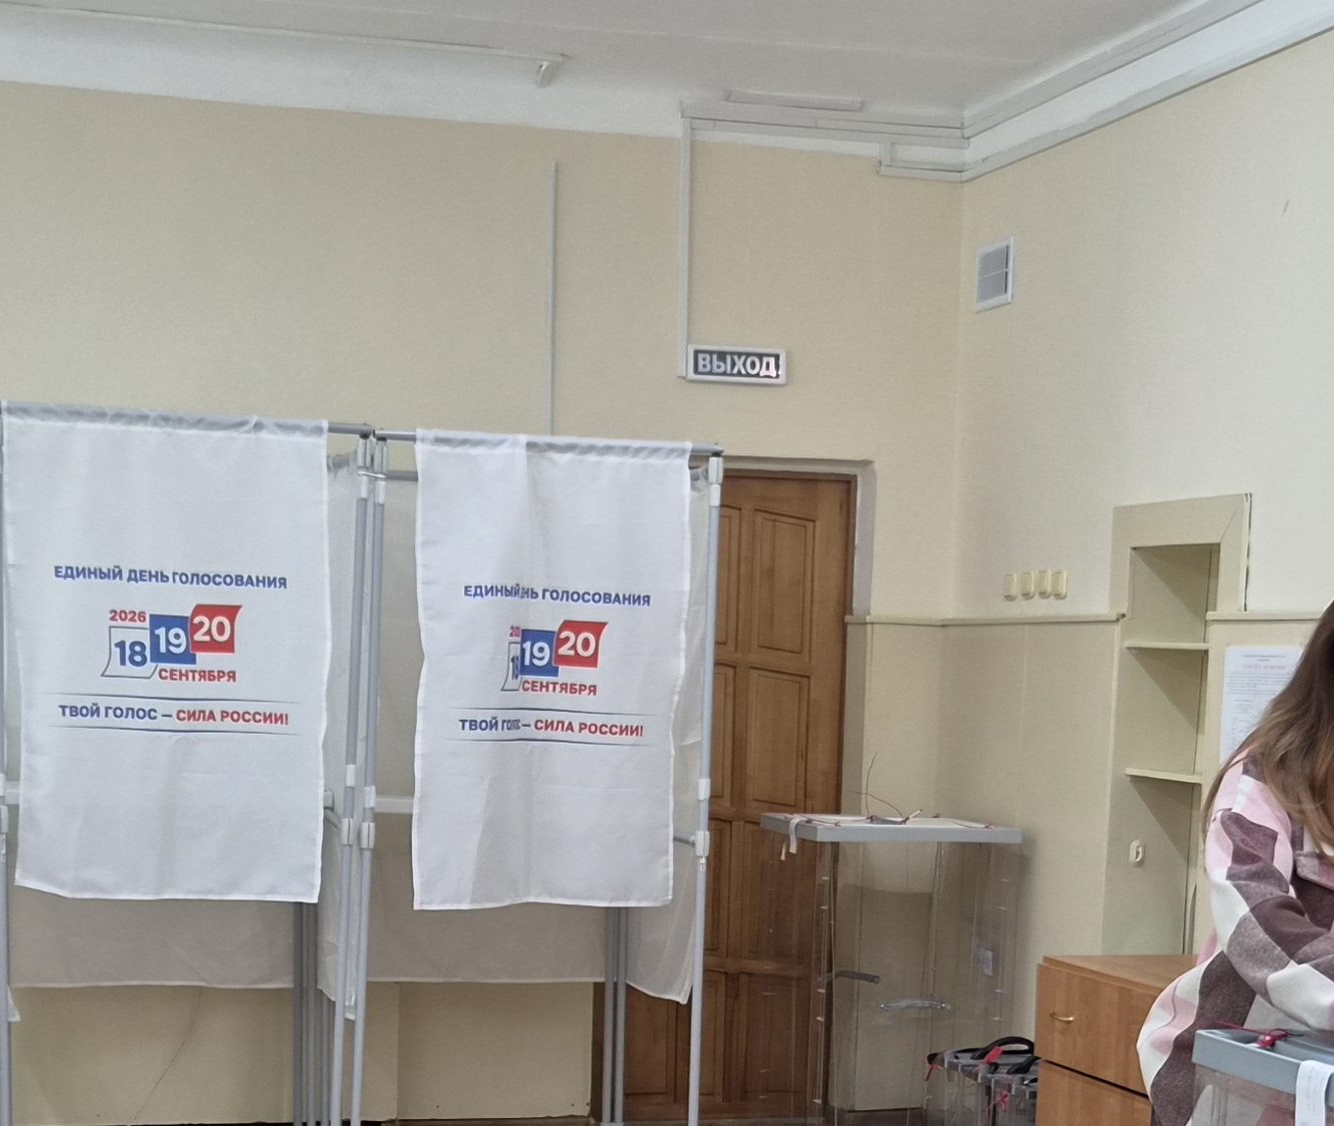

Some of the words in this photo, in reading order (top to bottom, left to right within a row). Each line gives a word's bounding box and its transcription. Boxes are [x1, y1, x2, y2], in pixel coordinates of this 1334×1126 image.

[697, 352, 777, 378] ВЫХОД
[54, 564, 124, 583] ЕДИНЫЙ
[126, 569, 170, 585] ДЕНЬ
[171, 571, 288, 590] ГОЛОСОВАНИЯ
[541, 588, 651, 607] ГОЛОСОВАНИЯ
[109, 609, 147, 623] 2026
[113, 640, 148, 667] 18
[154, 627, 188, 655] 19
[192, 615, 232, 643] 20
[522, 641, 551, 667] 19
[557, 631, 596, 658] 20
[157, 668, 237, 683] СЕНТЯБРЯ
[521, 680, 597, 696] СЕНТЯБРЯ
[58, 703, 101, 719] ТВОЙ
[104, 706, 158, 721] ГОЛОС
[175, 709, 217, 723] СИЛА
[219, 711, 289, 726] РОССИИ!
[459, 717, 499, 732] ТВОЙ
[533, 719, 575, 733] СИЛА
[578, 722, 644, 738] РОССИИ!
